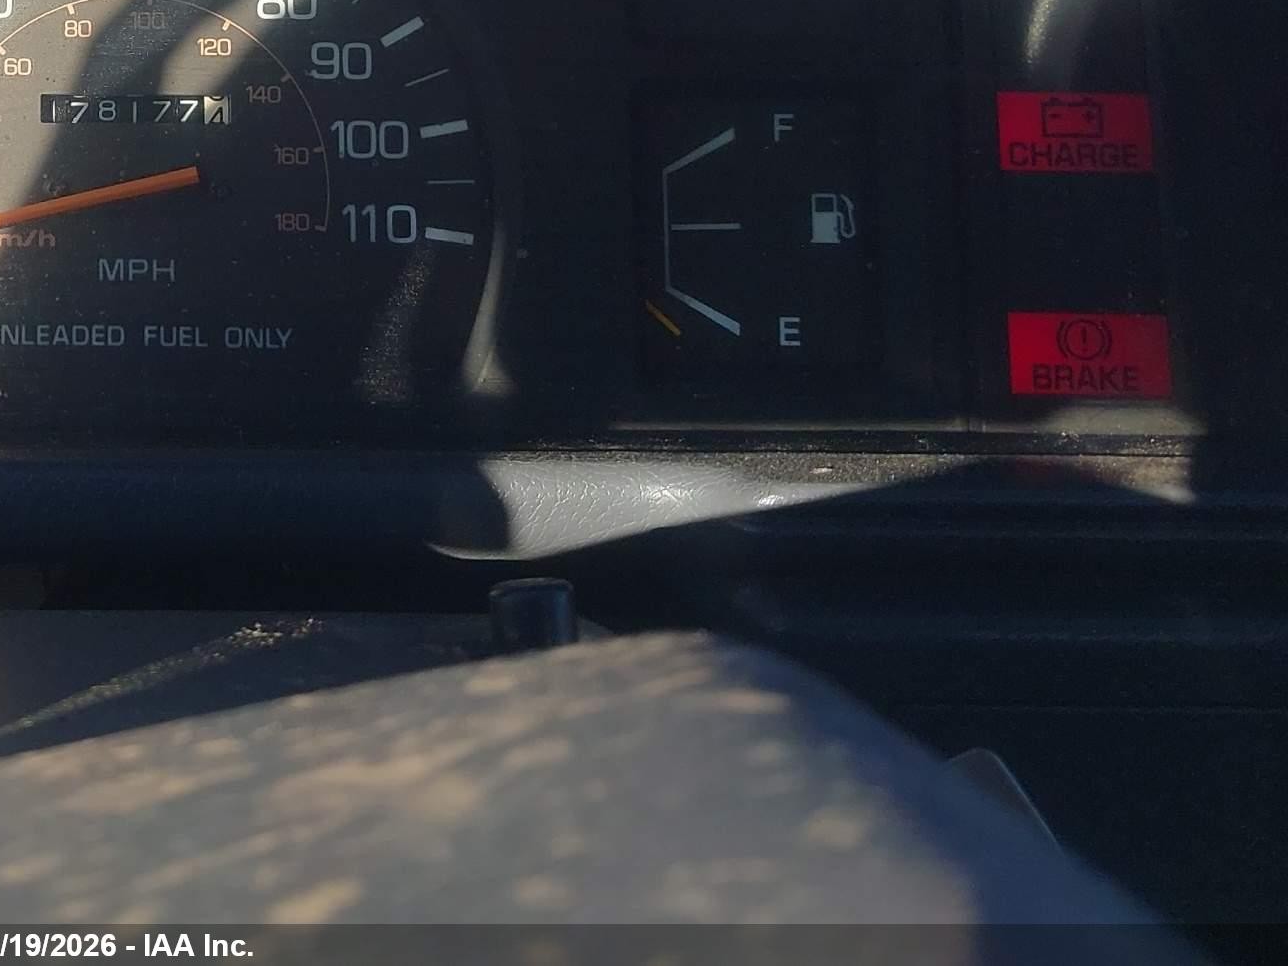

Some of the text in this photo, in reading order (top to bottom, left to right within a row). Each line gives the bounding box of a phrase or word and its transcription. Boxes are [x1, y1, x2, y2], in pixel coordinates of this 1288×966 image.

[63, 19, 93, 38] 80
[129, 11, 166, 31] 100
[196, 37, 232, 57] 120
[3, 57, 32, 76] 60
[310, 41, 373, 81] 90
[245, 85, 282, 104] 140
[329, 119, 410, 160] 100
[773, 113, 794, 142] F
[273, 146, 310, 165] 160
[1008, 141, 1140, 169] CHARGE
[274, 212, 311, 232] 180
[341, 203, 417, 244] 110
[97, 257, 176, 283] MPH
[143, 325, 209, 347] FUEL
[223, 326, 294, 349] ONLY
[778, 316, 802, 347] E
[1032, 364, 1141, 394] BRAKE
